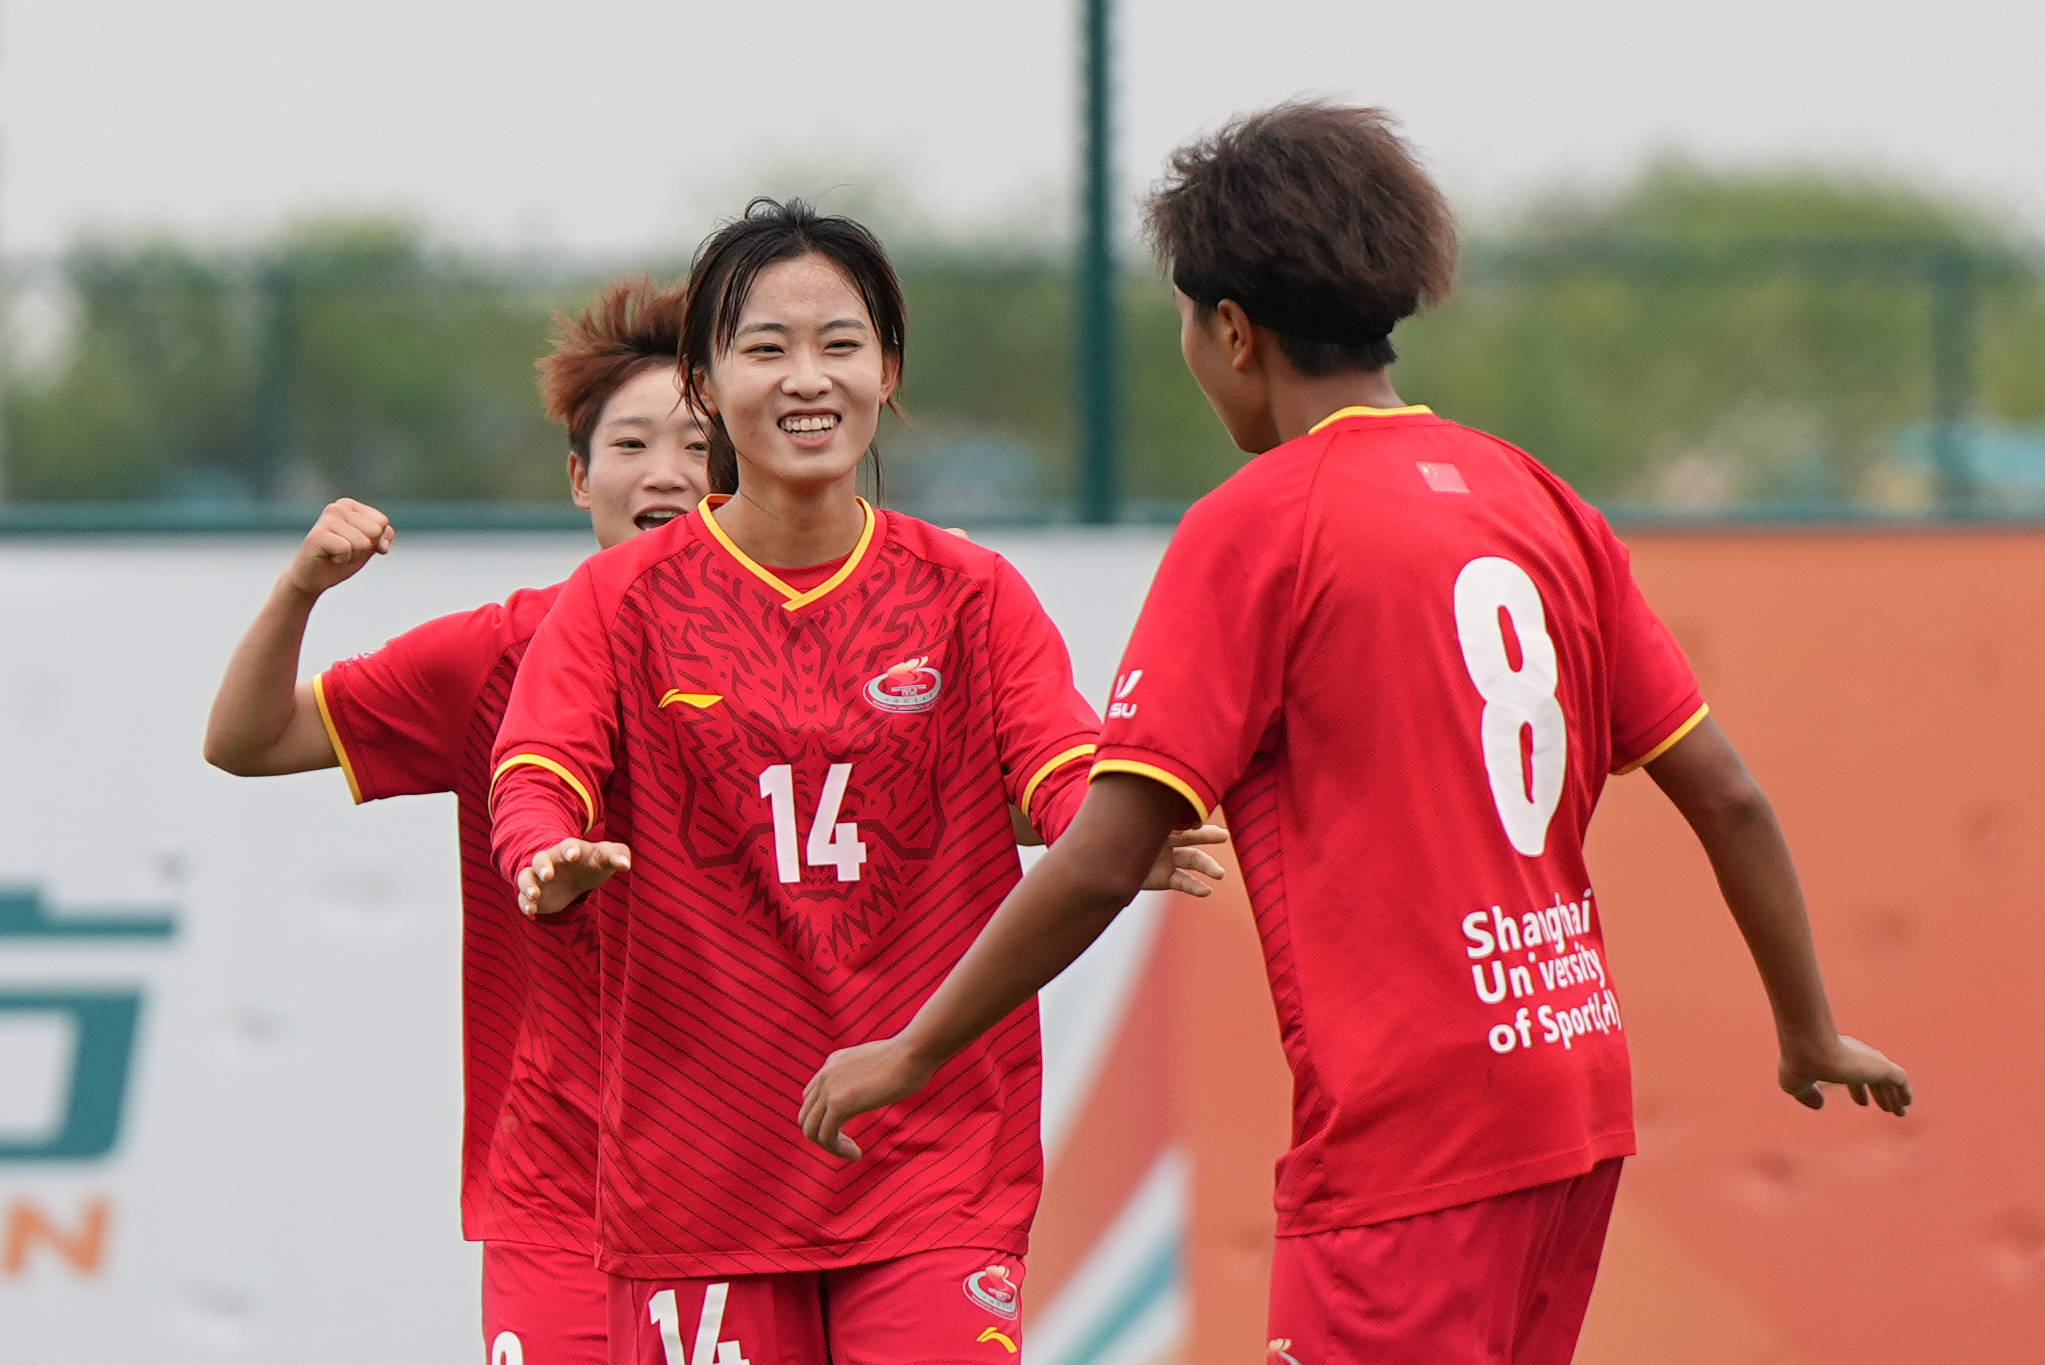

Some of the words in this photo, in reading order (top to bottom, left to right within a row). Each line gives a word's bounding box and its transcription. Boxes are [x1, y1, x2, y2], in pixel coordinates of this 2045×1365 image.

[1454, 556, 1567, 857] 8
[759, 763, 867, 883] 14
[1489, 1007, 1532, 1054] of
[648, 1282, 751, 1365] 14
